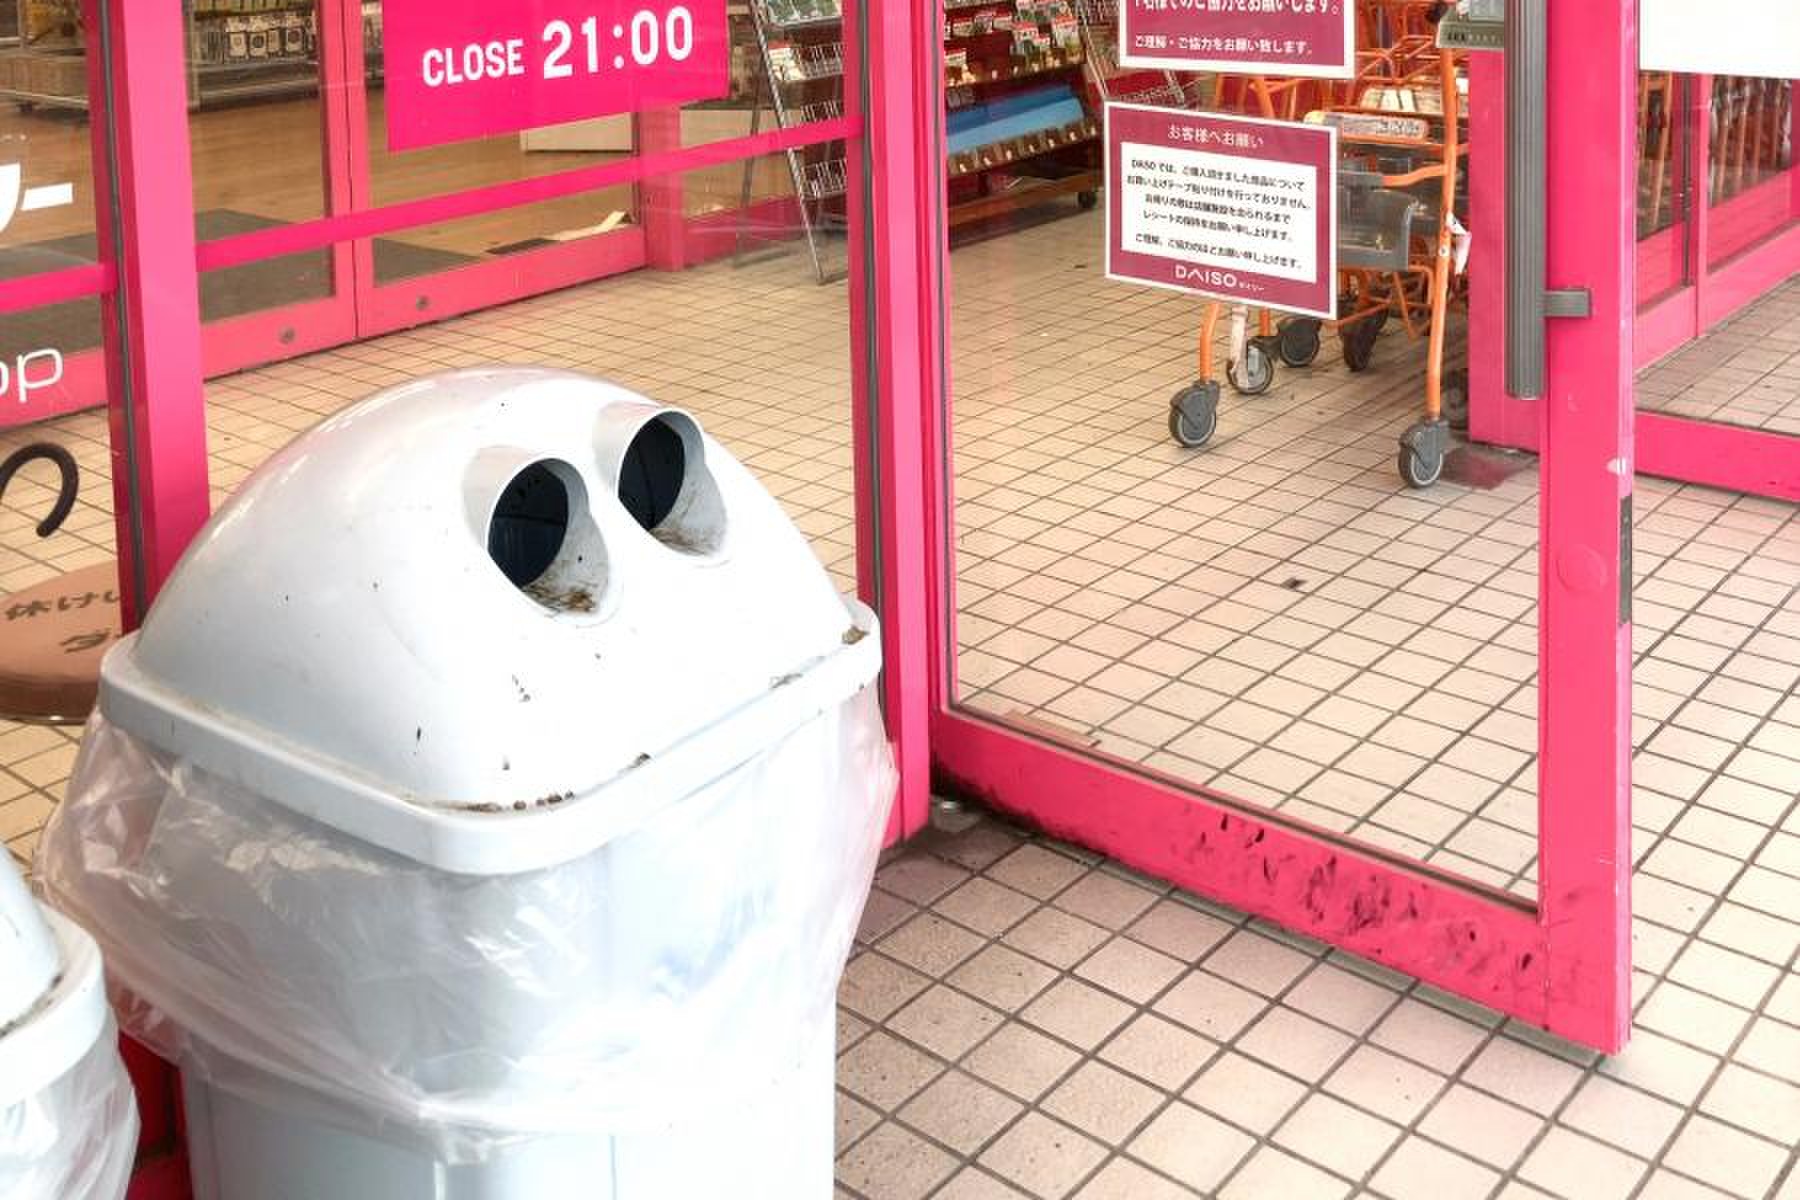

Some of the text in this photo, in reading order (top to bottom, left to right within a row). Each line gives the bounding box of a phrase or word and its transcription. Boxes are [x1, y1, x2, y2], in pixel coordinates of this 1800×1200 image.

[422, 6, 693, 87] CLOSE 21:00
[1174, 265, 1237, 288] DAISO
